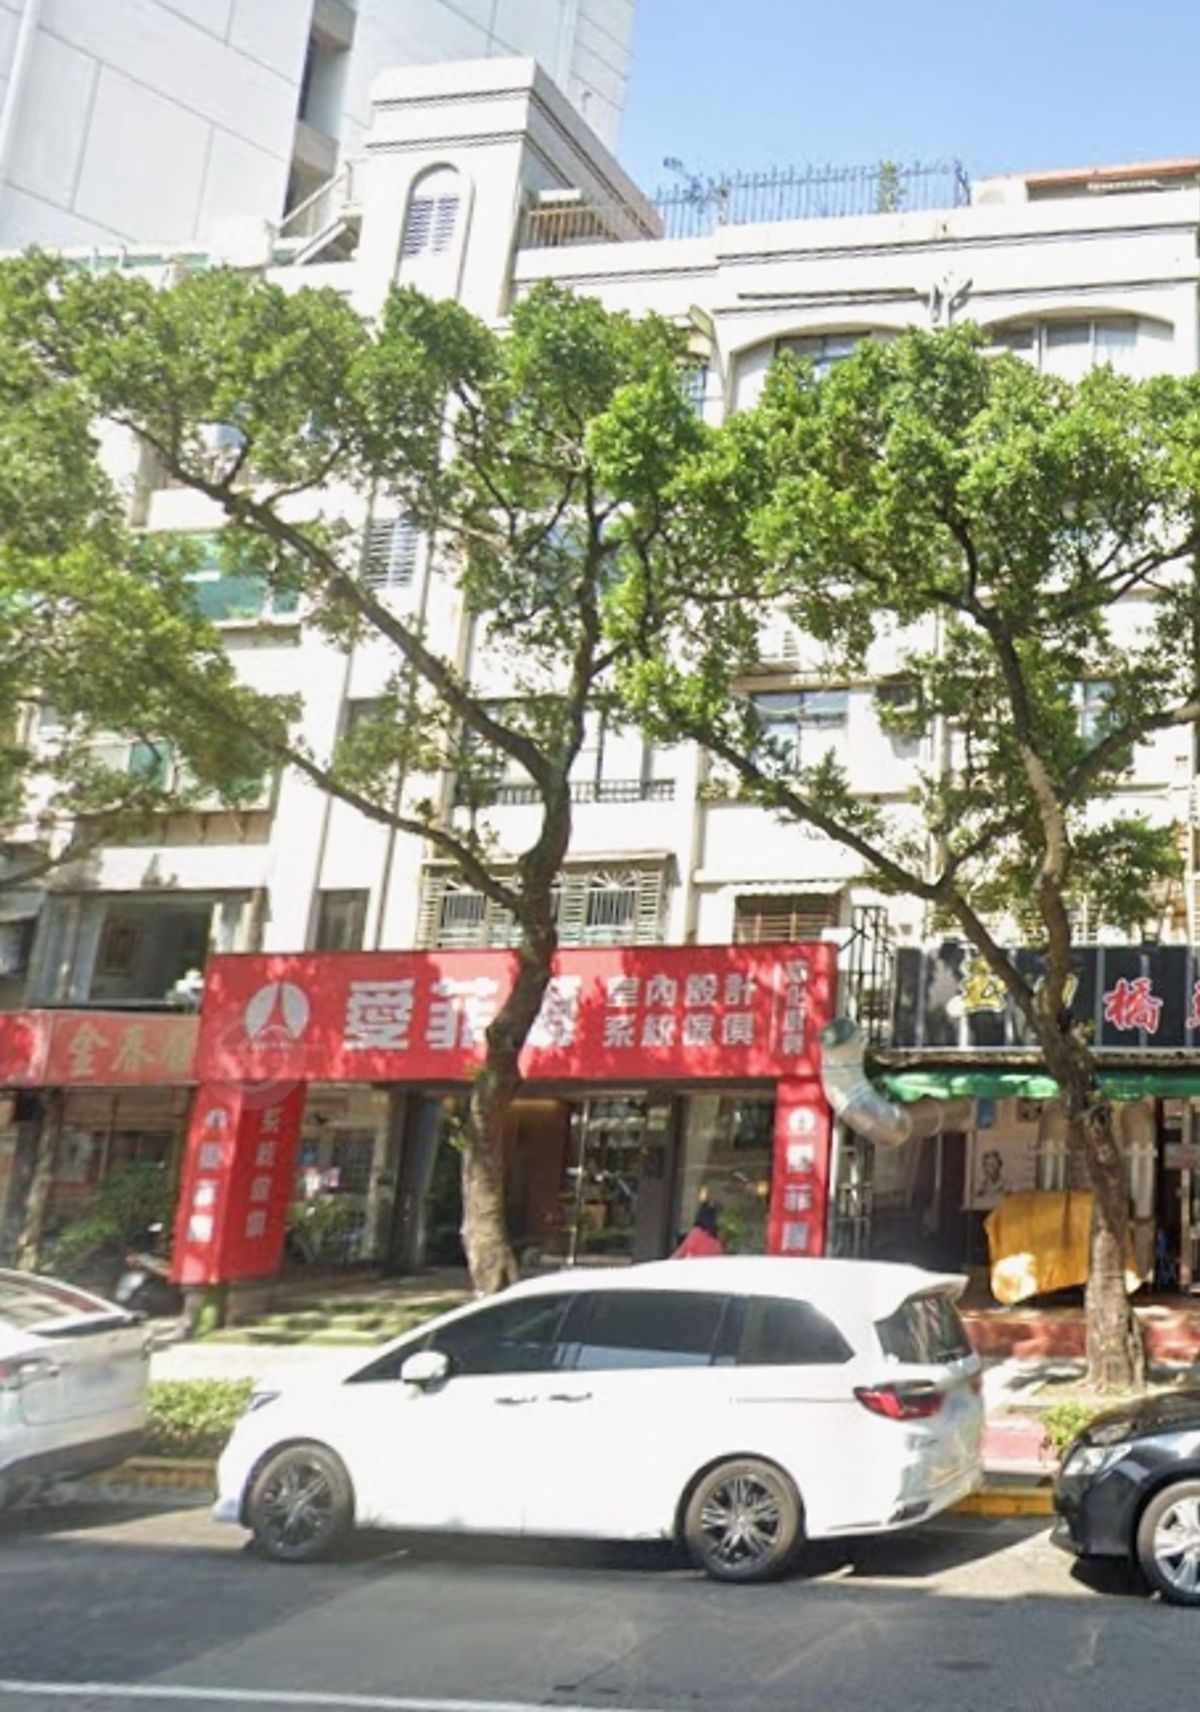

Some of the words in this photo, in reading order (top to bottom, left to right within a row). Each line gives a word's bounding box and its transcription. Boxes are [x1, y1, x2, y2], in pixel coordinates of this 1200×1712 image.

[606, 972, 757, 1007] 室內設計
[603, 1011, 755, 1048] 系統傢俱
